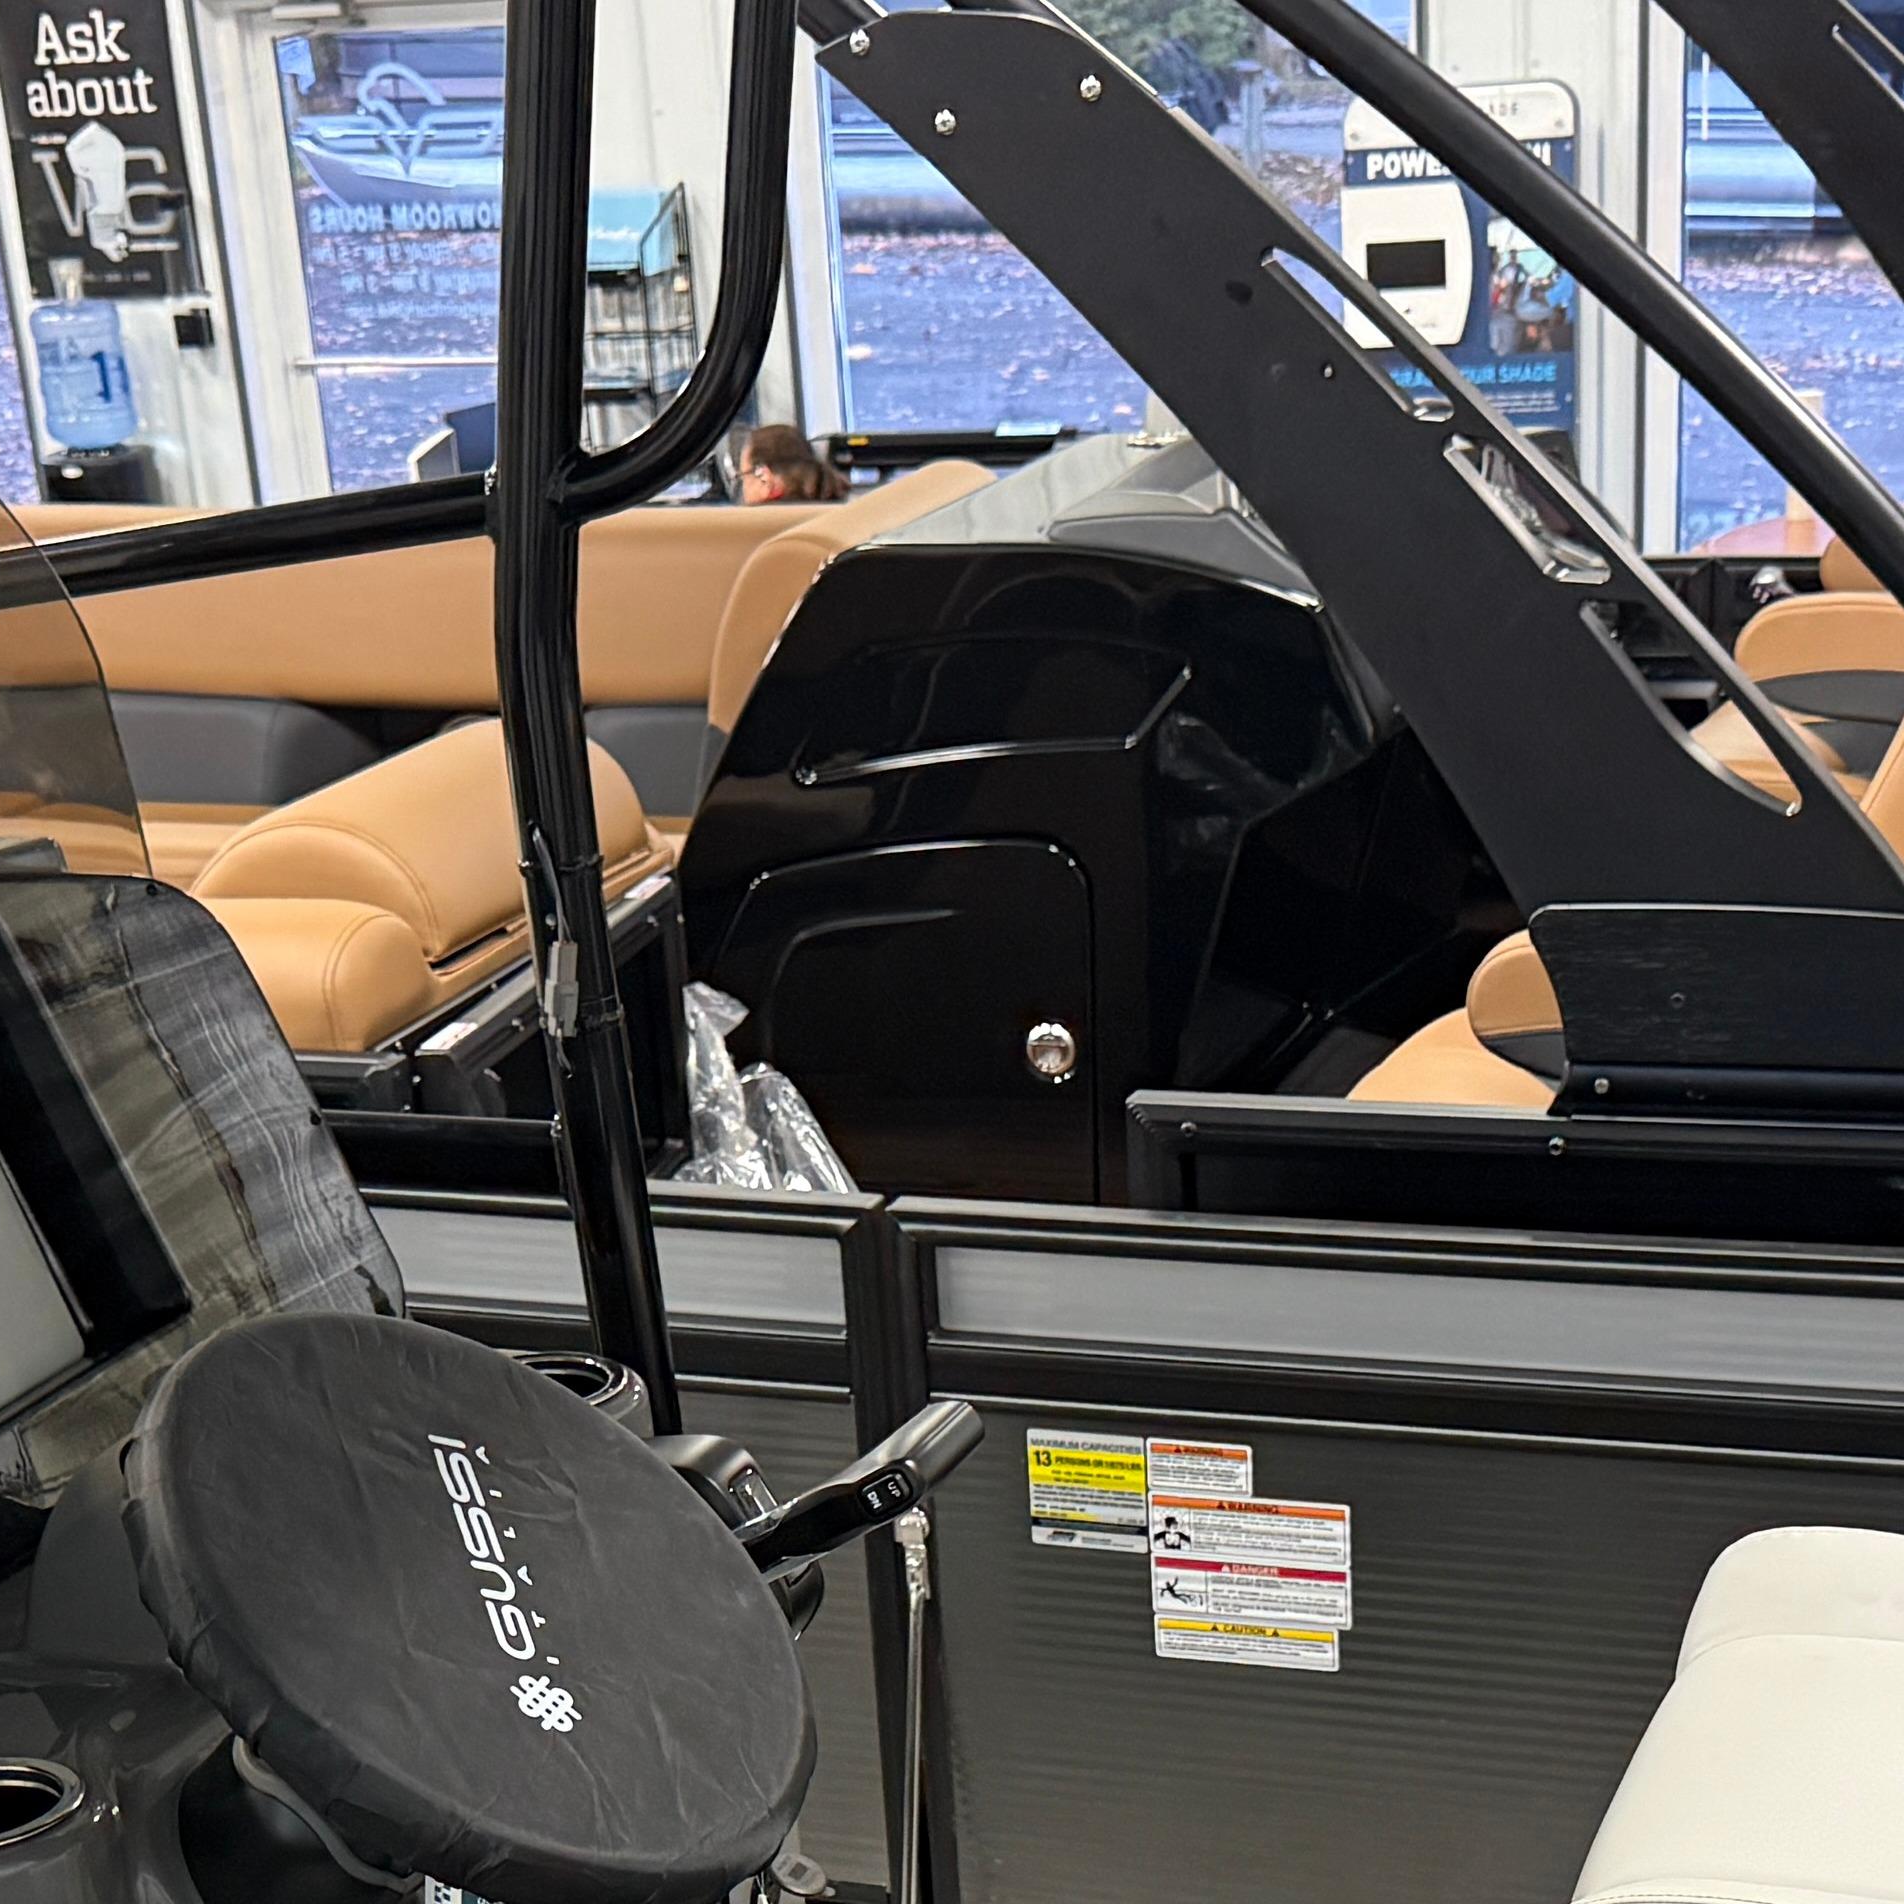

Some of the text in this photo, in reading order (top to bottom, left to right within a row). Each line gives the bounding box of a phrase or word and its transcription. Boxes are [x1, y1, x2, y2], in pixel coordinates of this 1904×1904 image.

[34, 8, 130, 66] Ask
[26, 67, 158, 118] about
[1366, 150, 1454, 180] POWE
[1499, 361, 1558, 384] SHADE
[1033, 1449, 1053, 1468] 13
[1081, 1441, 1142, 1455] CAPACITIES
[887, 1481, 902, 1498] UP
[427, 1433, 536, 1661] GUSSI
[475, 1445, 561, 1666] ITALIA
[1232, 1564, 1280, 1577] DANGER
[1222, 1622, 1267, 1636] CAUTION
